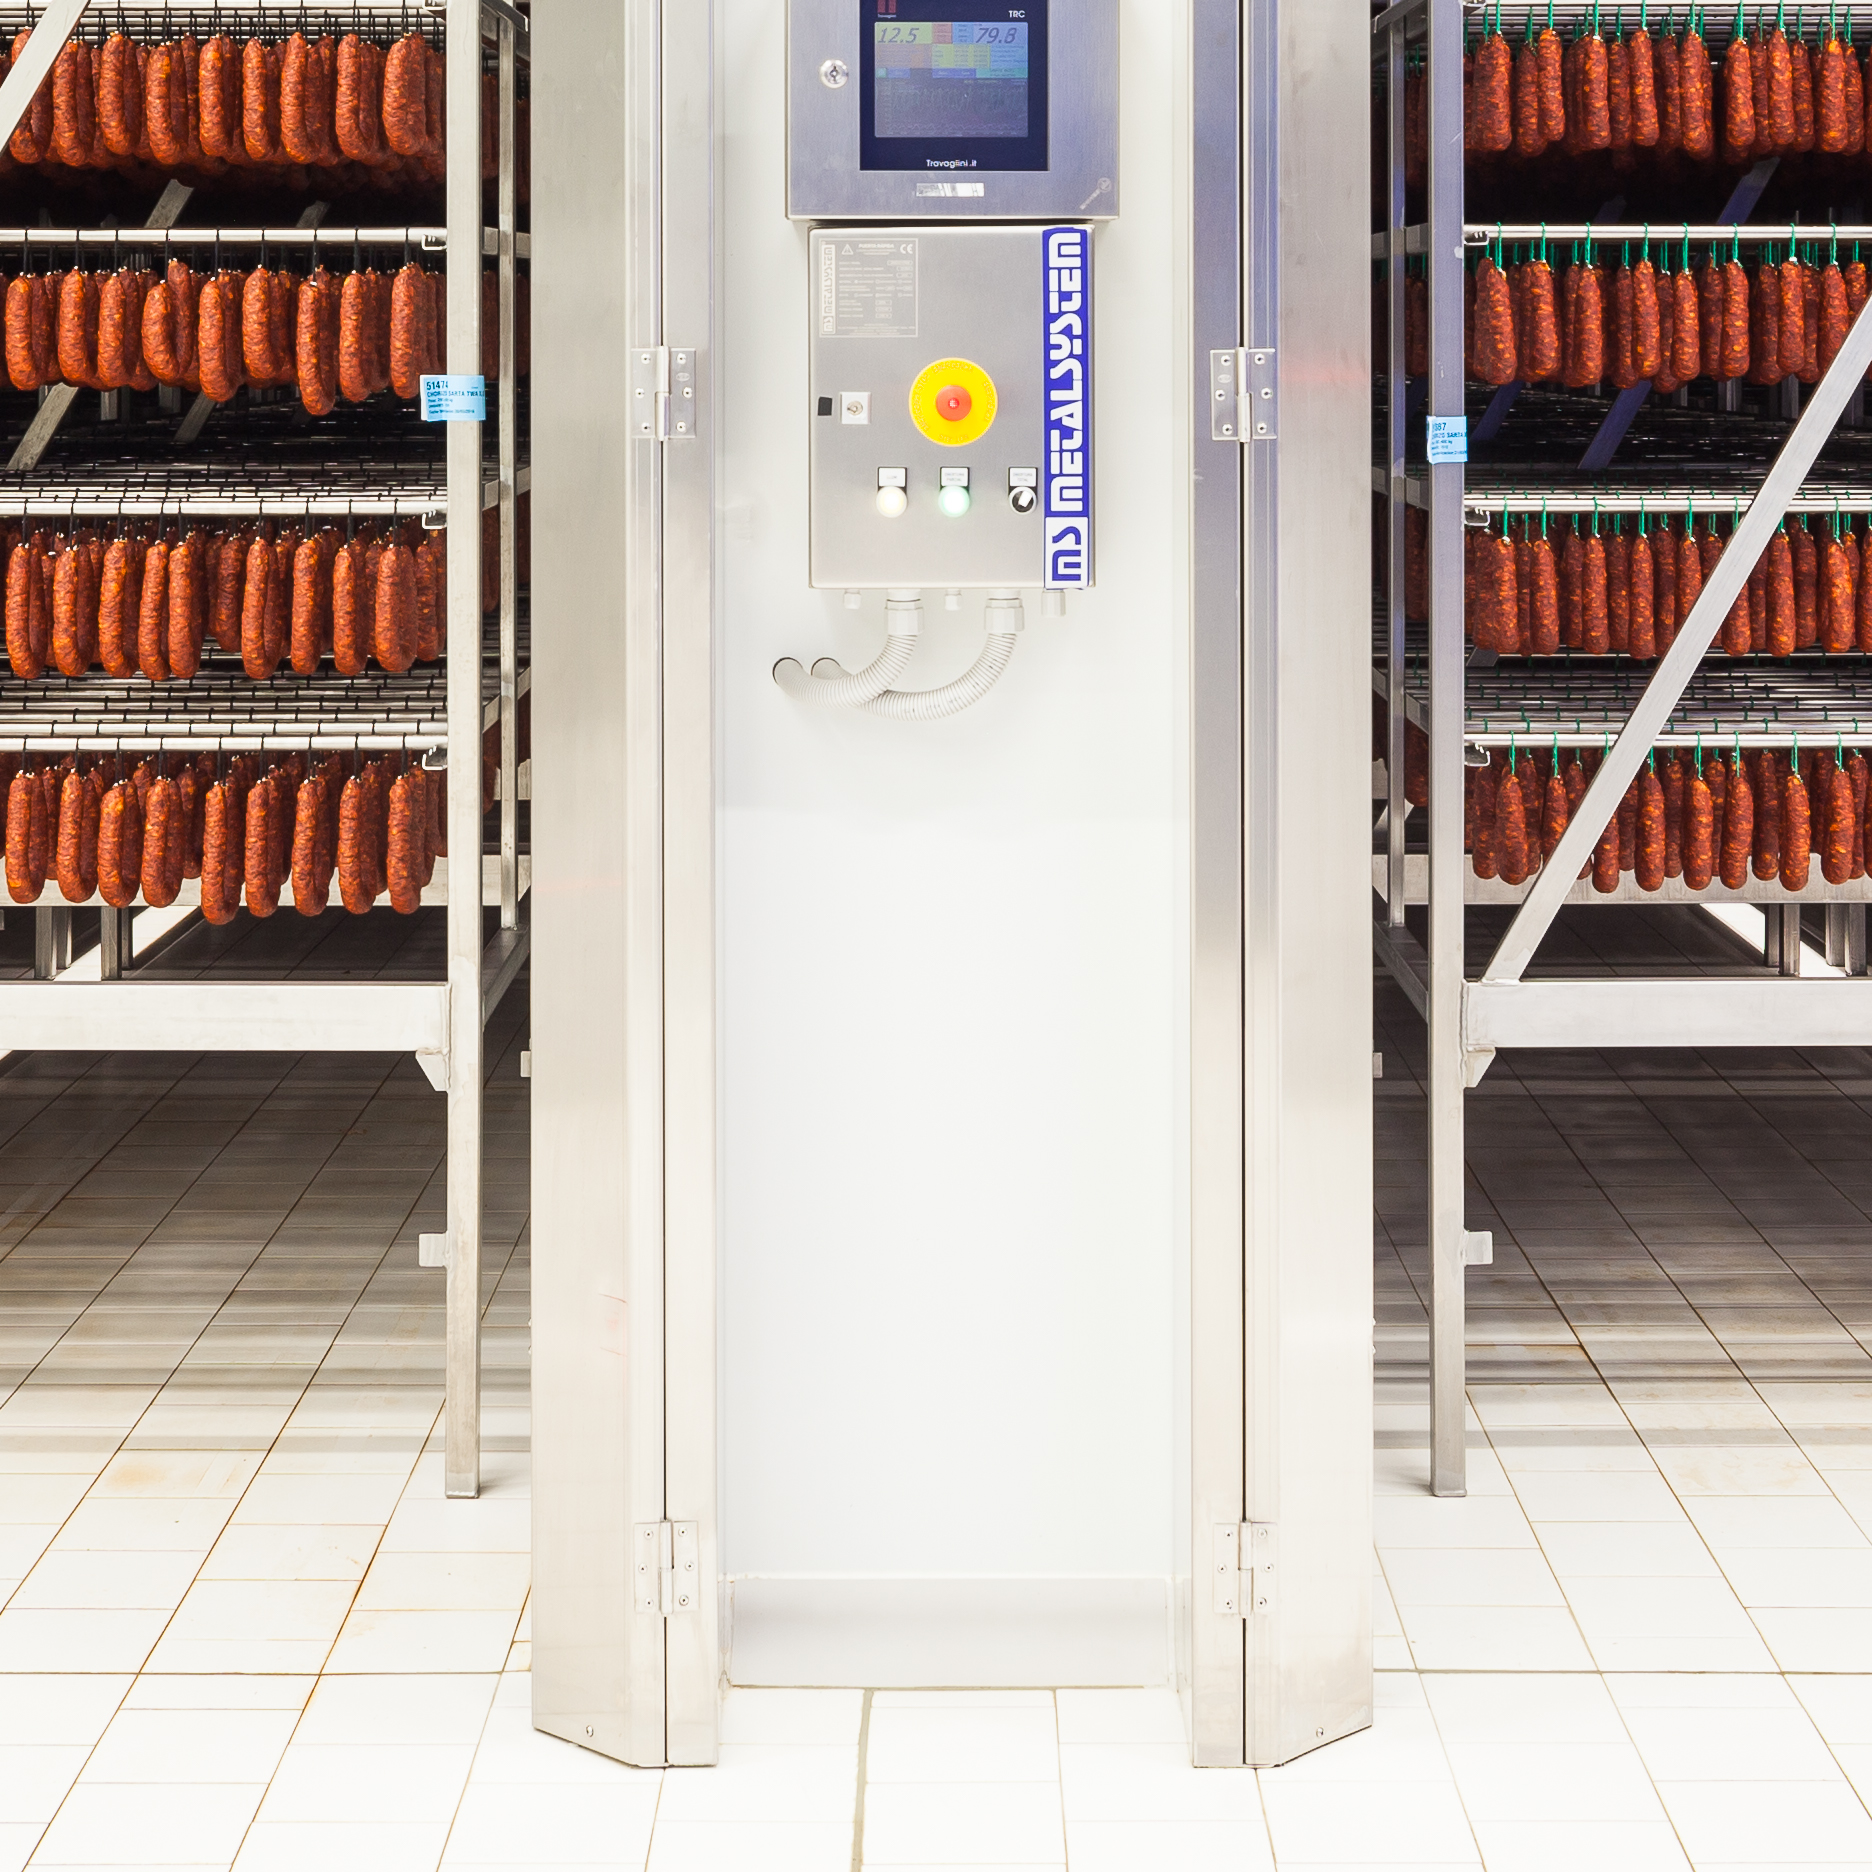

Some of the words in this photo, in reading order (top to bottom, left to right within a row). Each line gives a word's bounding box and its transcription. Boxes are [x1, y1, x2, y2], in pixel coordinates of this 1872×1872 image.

[1008, 10, 1026, 18] TRC
[878, 28, 919, 43] 12.5
[976, 28, 1017, 43] 79.8
[1048, 231, 1083, 513] METALSYSTEM
